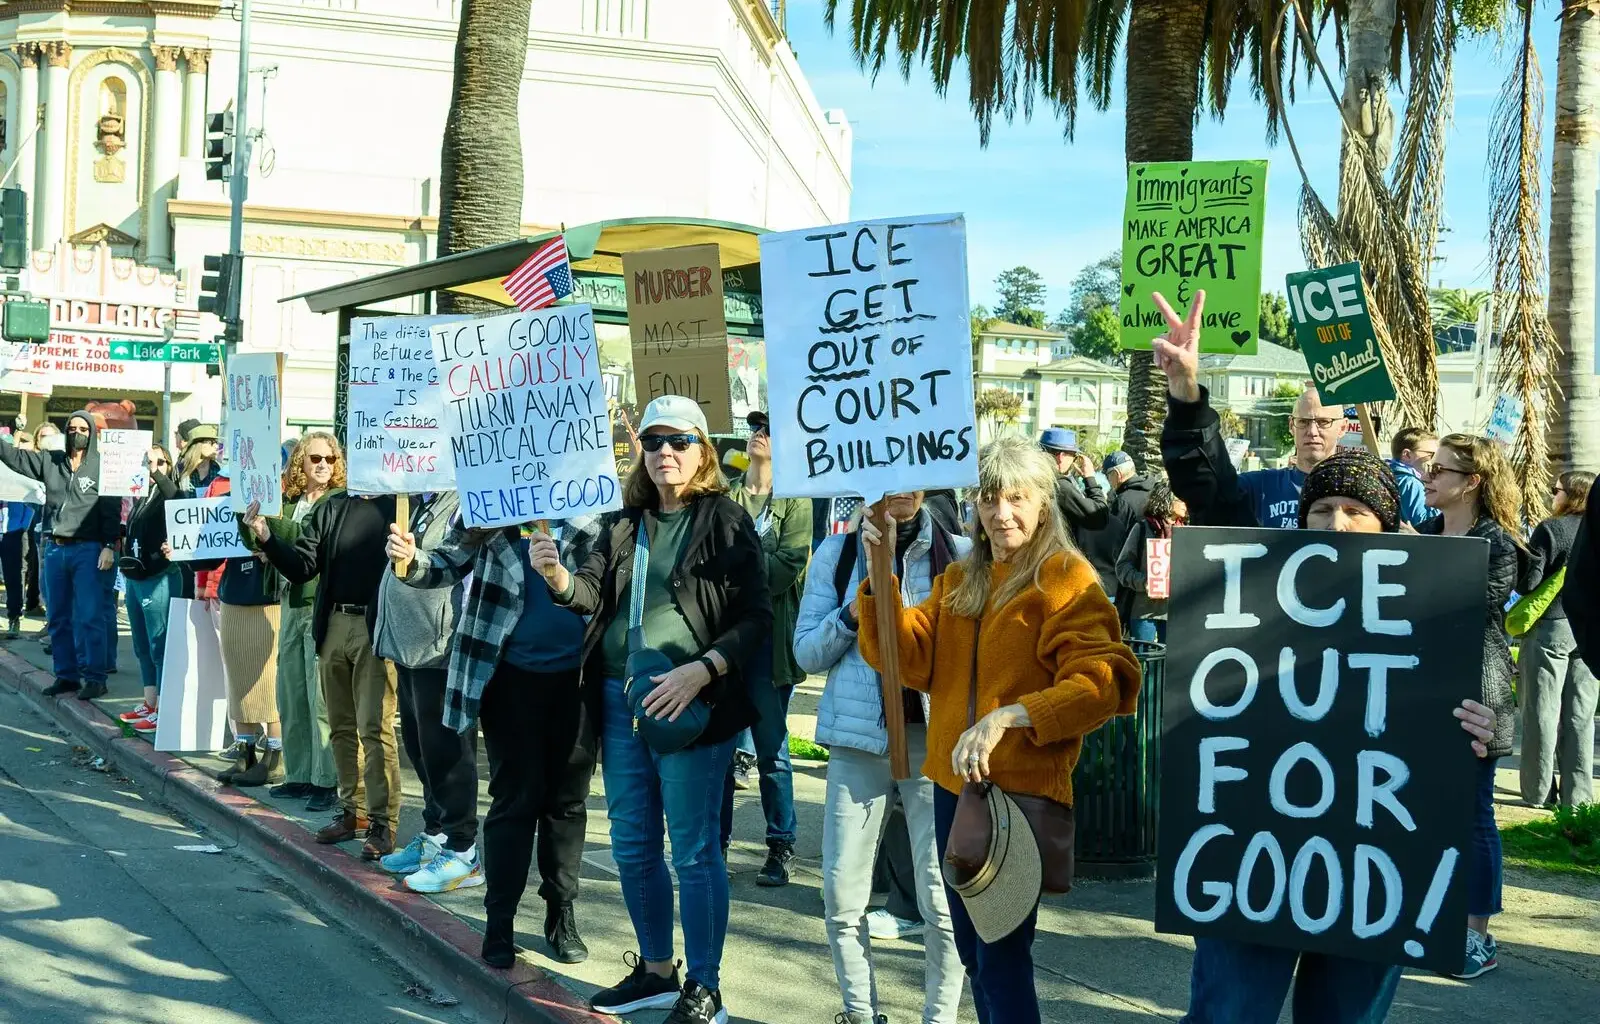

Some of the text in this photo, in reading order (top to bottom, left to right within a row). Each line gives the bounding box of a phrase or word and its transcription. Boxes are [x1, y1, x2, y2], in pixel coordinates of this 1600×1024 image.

[1136, 167, 1253, 215] immigrants
[1128, 215, 1251, 240] MAKE AMERICA
[805, 224, 915, 277] ICE
[1136, 243, 1246, 280] GREAT
[634, 266, 713, 305] MURDER
[824, 279, 919, 327] GET
[1177, 278, 1190, 307] &
[1289, 274, 1364, 323] ICE
[49, 333, 76, 344] FIRE
[362, 322, 387, 340] The
[437, 312, 590, 362] ICE GOONS
[644, 319, 708, 355] MOST
[1317, 322, 1352, 344] OUT OF
[33, 345, 110, 360] PREME ZOO
[33, 359, 124, 374] NG NEIGHBORS
[133, 344, 200, 359] Lake Park
[373, 343, 433, 361] Betwee
[808, 334, 924, 373] OUT OF
[1314, 338, 1380, 383] Oakland
[350, 366, 380, 383] ICE
[388, 368, 395, 379] &
[401, 367, 422, 382] The
[449, 344, 591, 397] CALLOUSLY
[230, 373, 253, 411] ICE
[394, 389, 417, 405] IS
[450, 380, 594, 432] TURN AWAY
[797, 370, 951, 433] COURT
[103, 431, 125, 444] ICE
[354, 411, 438, 428] The Gestapo
[233, 429, 256, 470] FOR
[355, 435, 384, 449] didn't
[451, 415, 608, 468] MEDICAL CARE
[805, 426, 972, 478] BUILDINGS
[382, 452, 437, 472] MASKS
[512, 461, 550, 484] FOR
[467, 475, 614, 525] RENEE GOOD
[1269, 500, 1298, 518] NOT
[173, 535, 191, 550] LA
[1203, 543, 1413, 635] ICE
[1190, 646, 1419, 738] OUT
[1197, 736, 1417, 832] FOR
[1173, 823, 1459, 957] GOOD!
